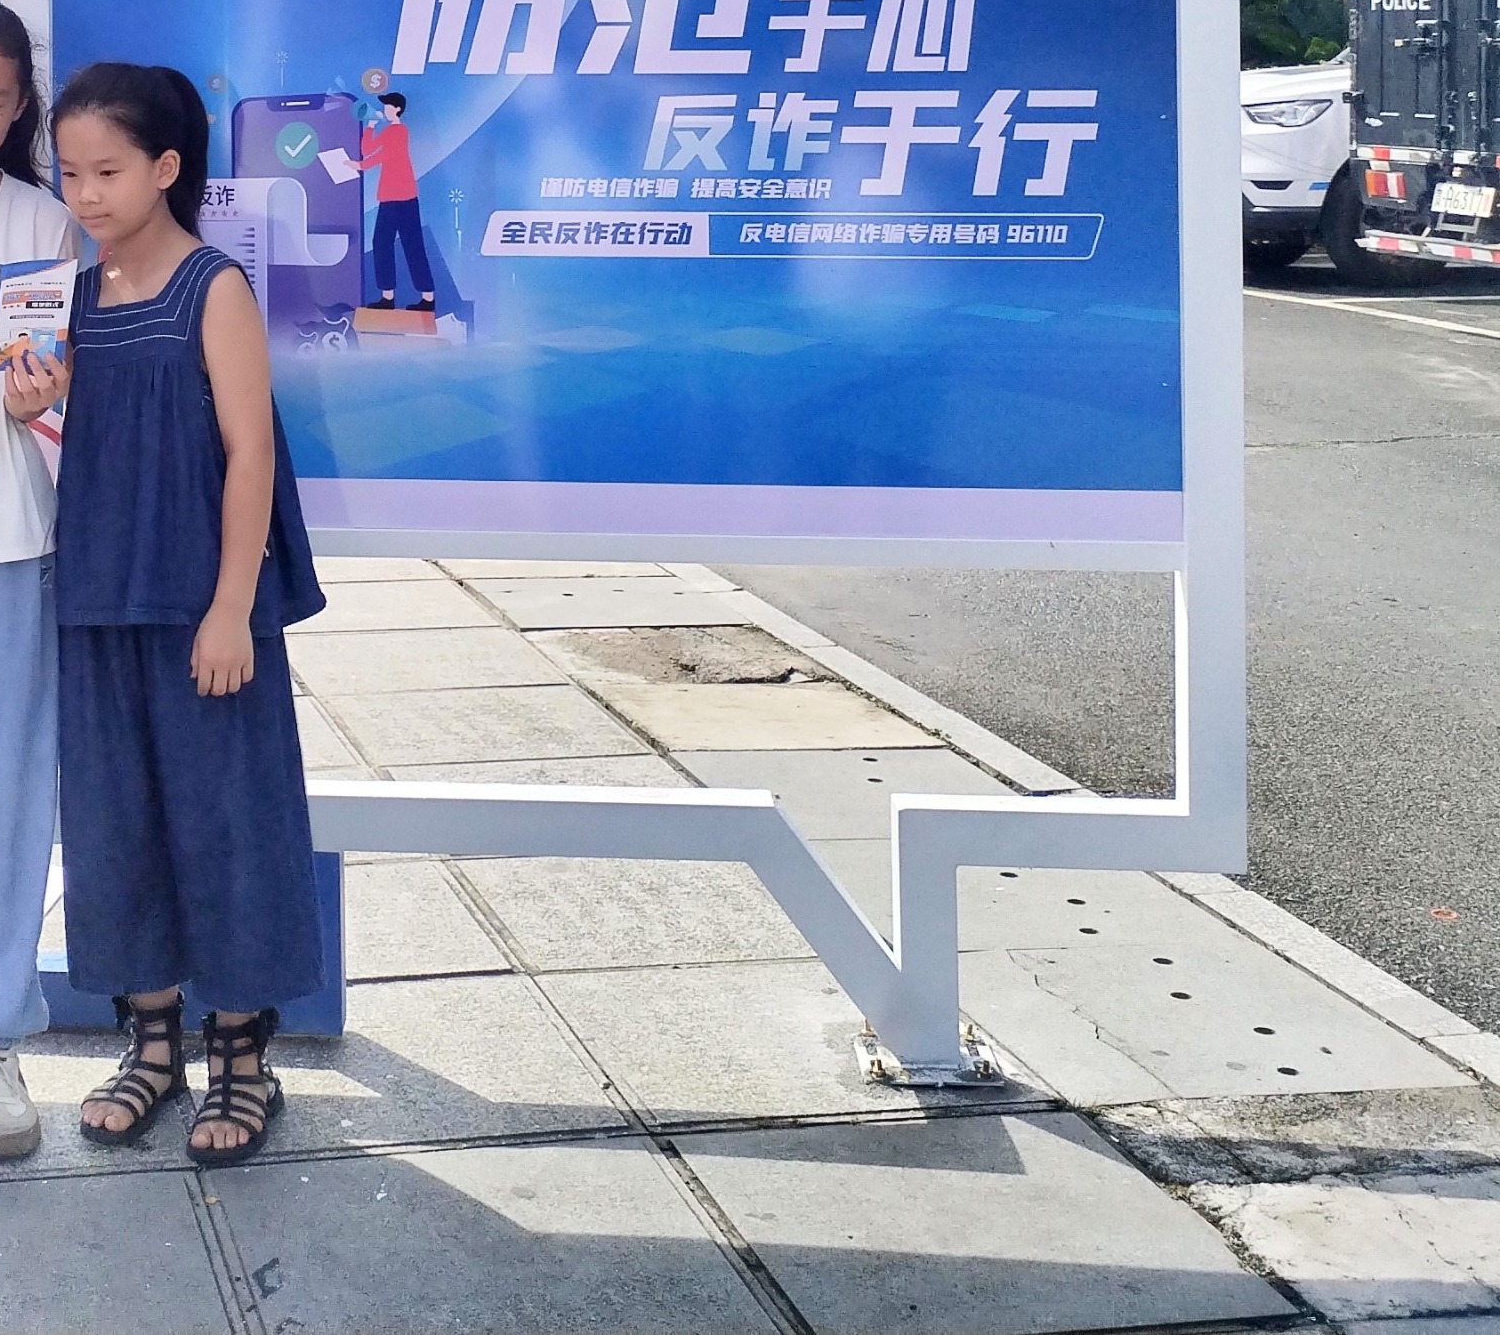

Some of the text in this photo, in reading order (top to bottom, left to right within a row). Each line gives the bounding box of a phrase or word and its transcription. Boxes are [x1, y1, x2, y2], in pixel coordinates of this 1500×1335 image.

[641, 88, 1099, 198] 反诈于行
[539, 176, 833, 200] 谨防电信诈骗 提高安全意识
[499, 220, 694, 248] 全民反诈在行动
[738, 221, 1070, 247] 反电信网络诈骗专用号码 96110
